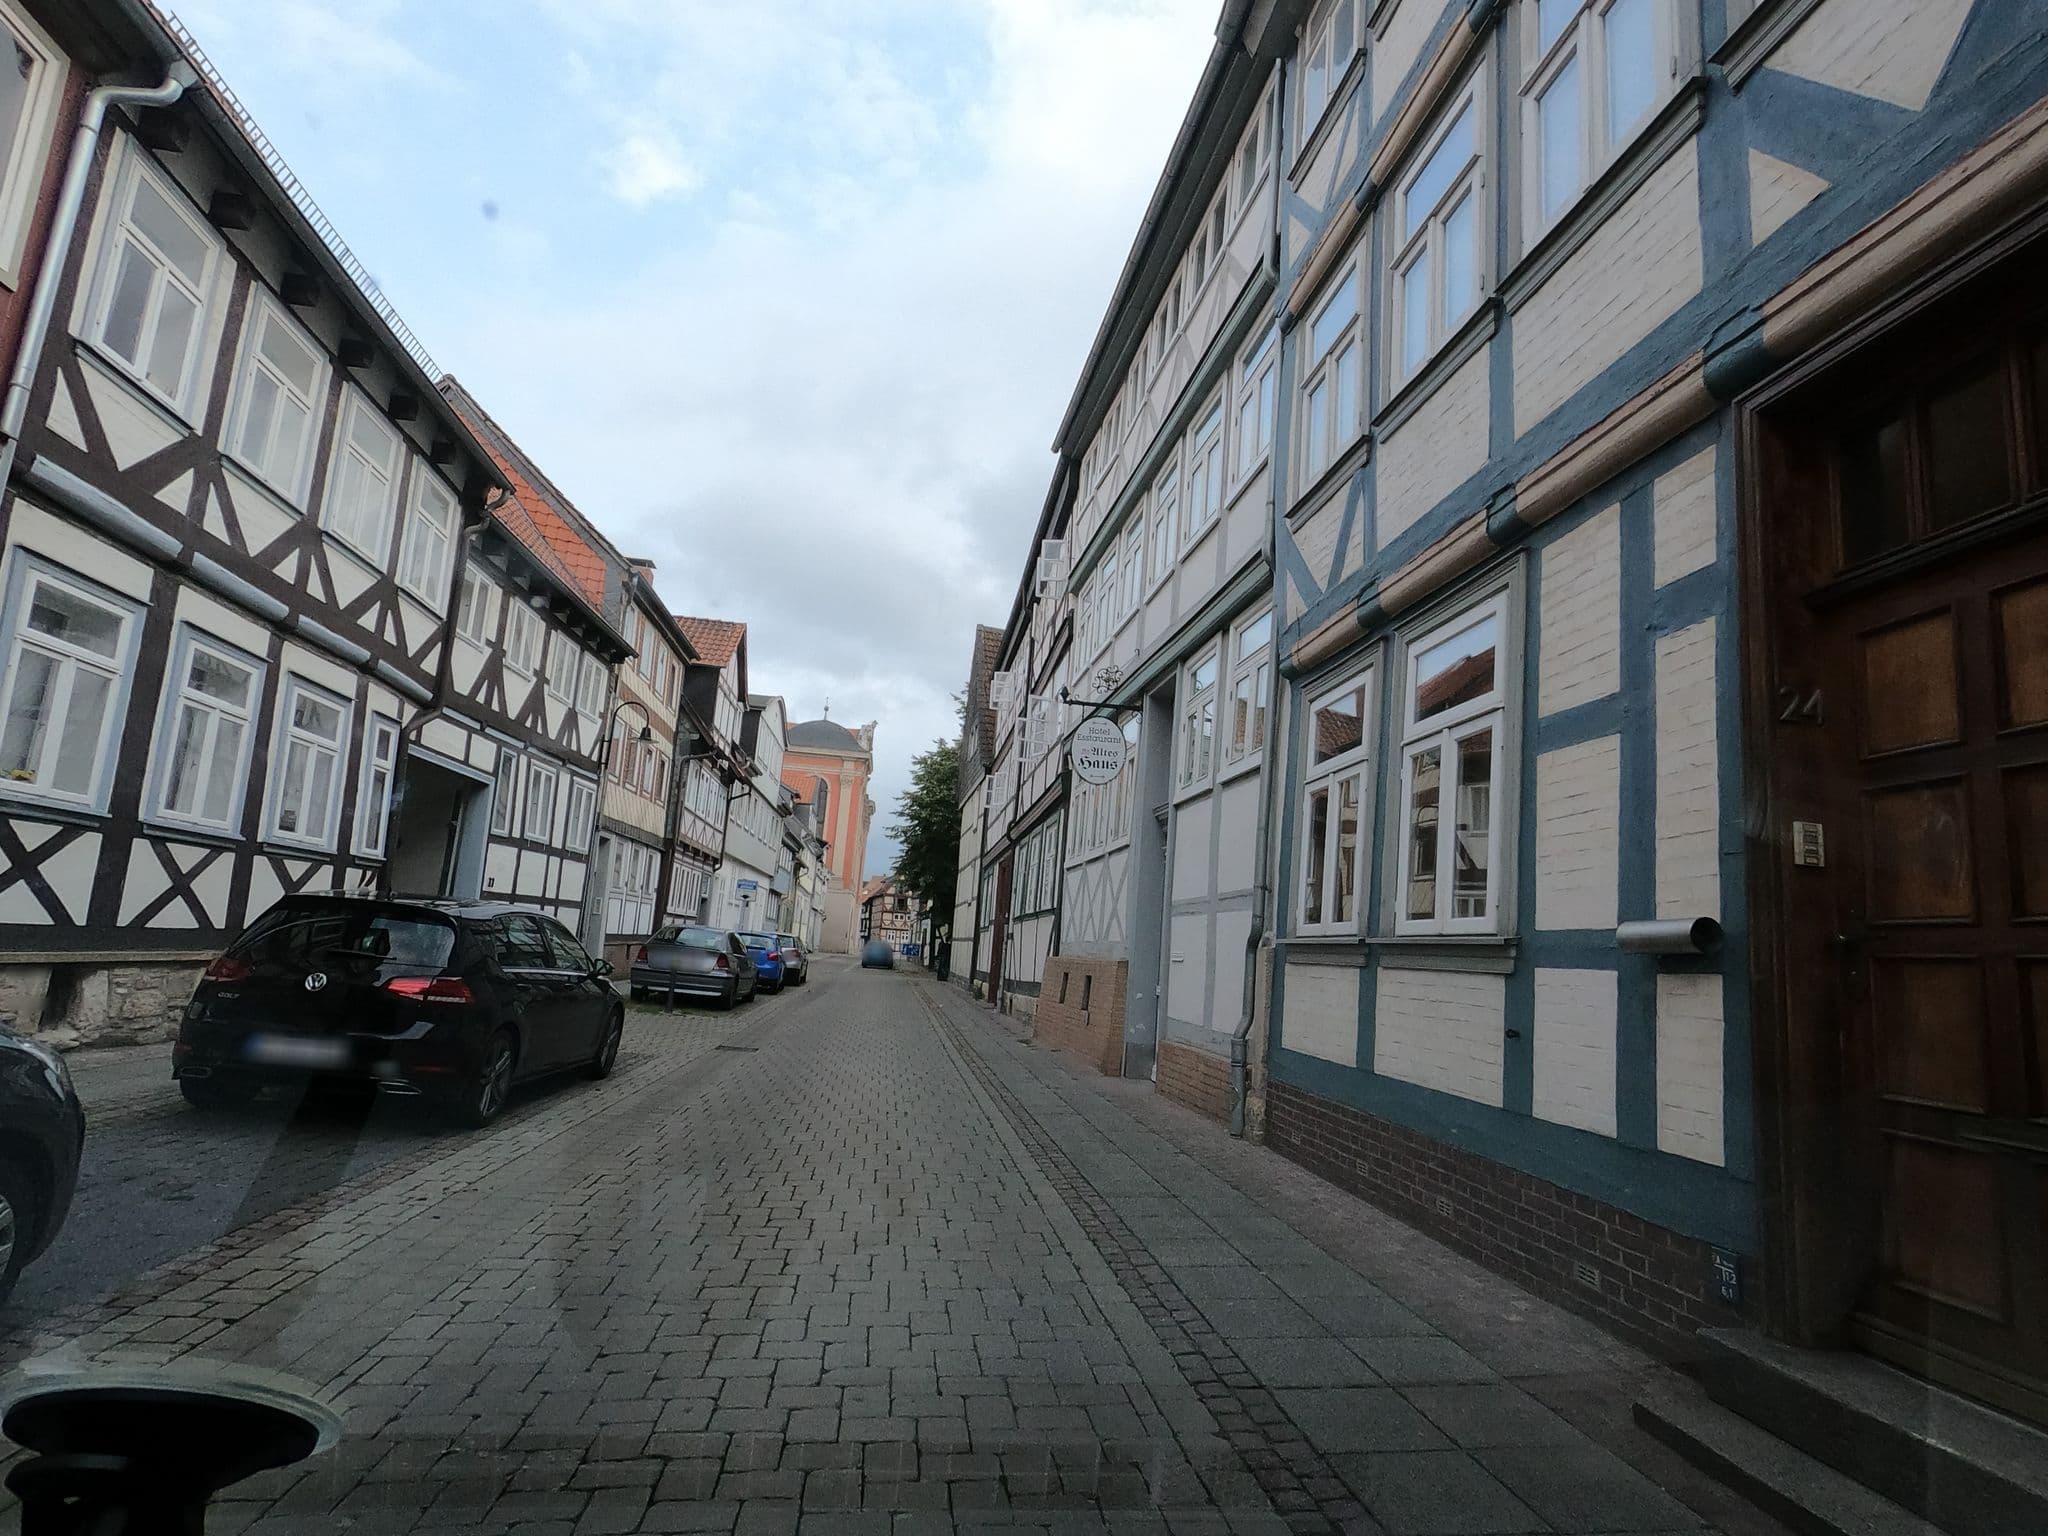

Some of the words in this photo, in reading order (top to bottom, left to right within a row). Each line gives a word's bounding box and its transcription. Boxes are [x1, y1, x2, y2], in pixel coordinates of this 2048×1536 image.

[1779, 686, 1824, 726] 24
[1088, 727, 1111, 736] Hotel
[1078, 756, 1118, 770] Haus
[217, 991, 240, 1000] GOLF
